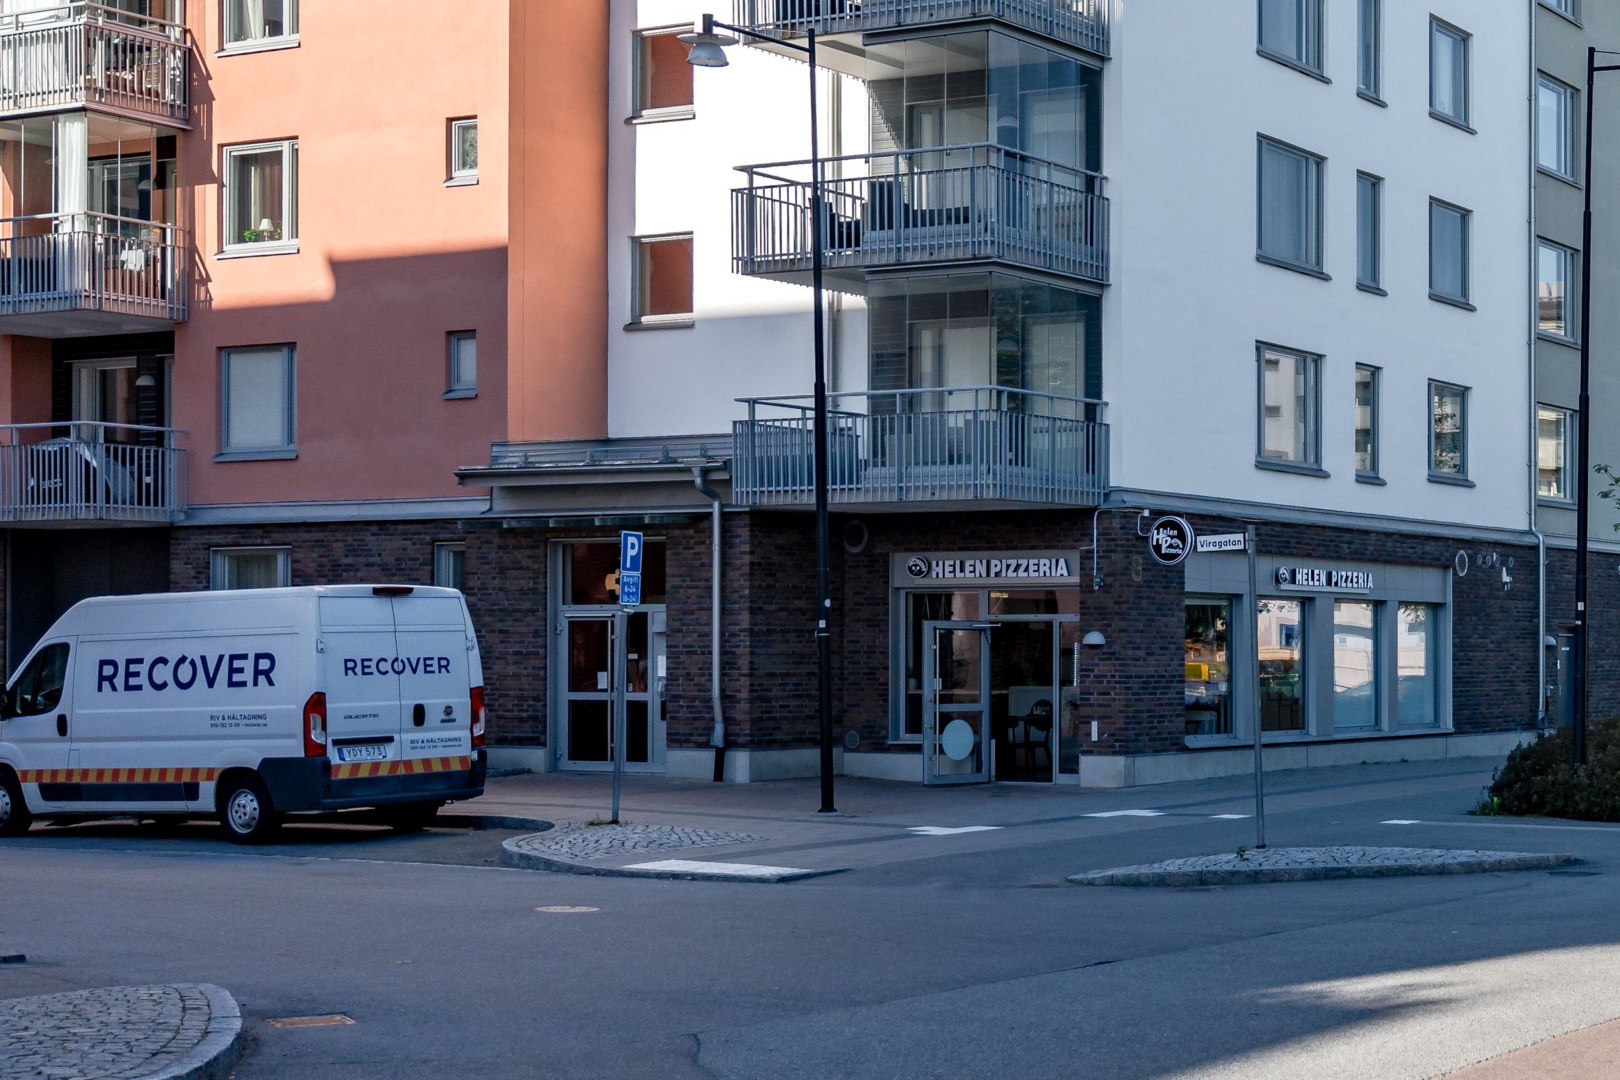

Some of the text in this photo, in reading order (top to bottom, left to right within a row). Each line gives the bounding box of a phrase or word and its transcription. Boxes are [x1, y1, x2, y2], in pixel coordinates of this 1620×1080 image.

[626, 536, 639, 568] P
[1199, 538, 1242, 549] Viragatan
[932, 559, 987, 578] HELEN
[990, 558, 1069, 577] PIZZERIA
[1295, 568, 1374, 589] HELEN PIZZERIA
[624, 585, 637, 593] 8-24
[97, 652, 276, 693] RECOVER
[343, 656, 451, 676] RECOVER
[346, 746, 383, 758] YDY 573
